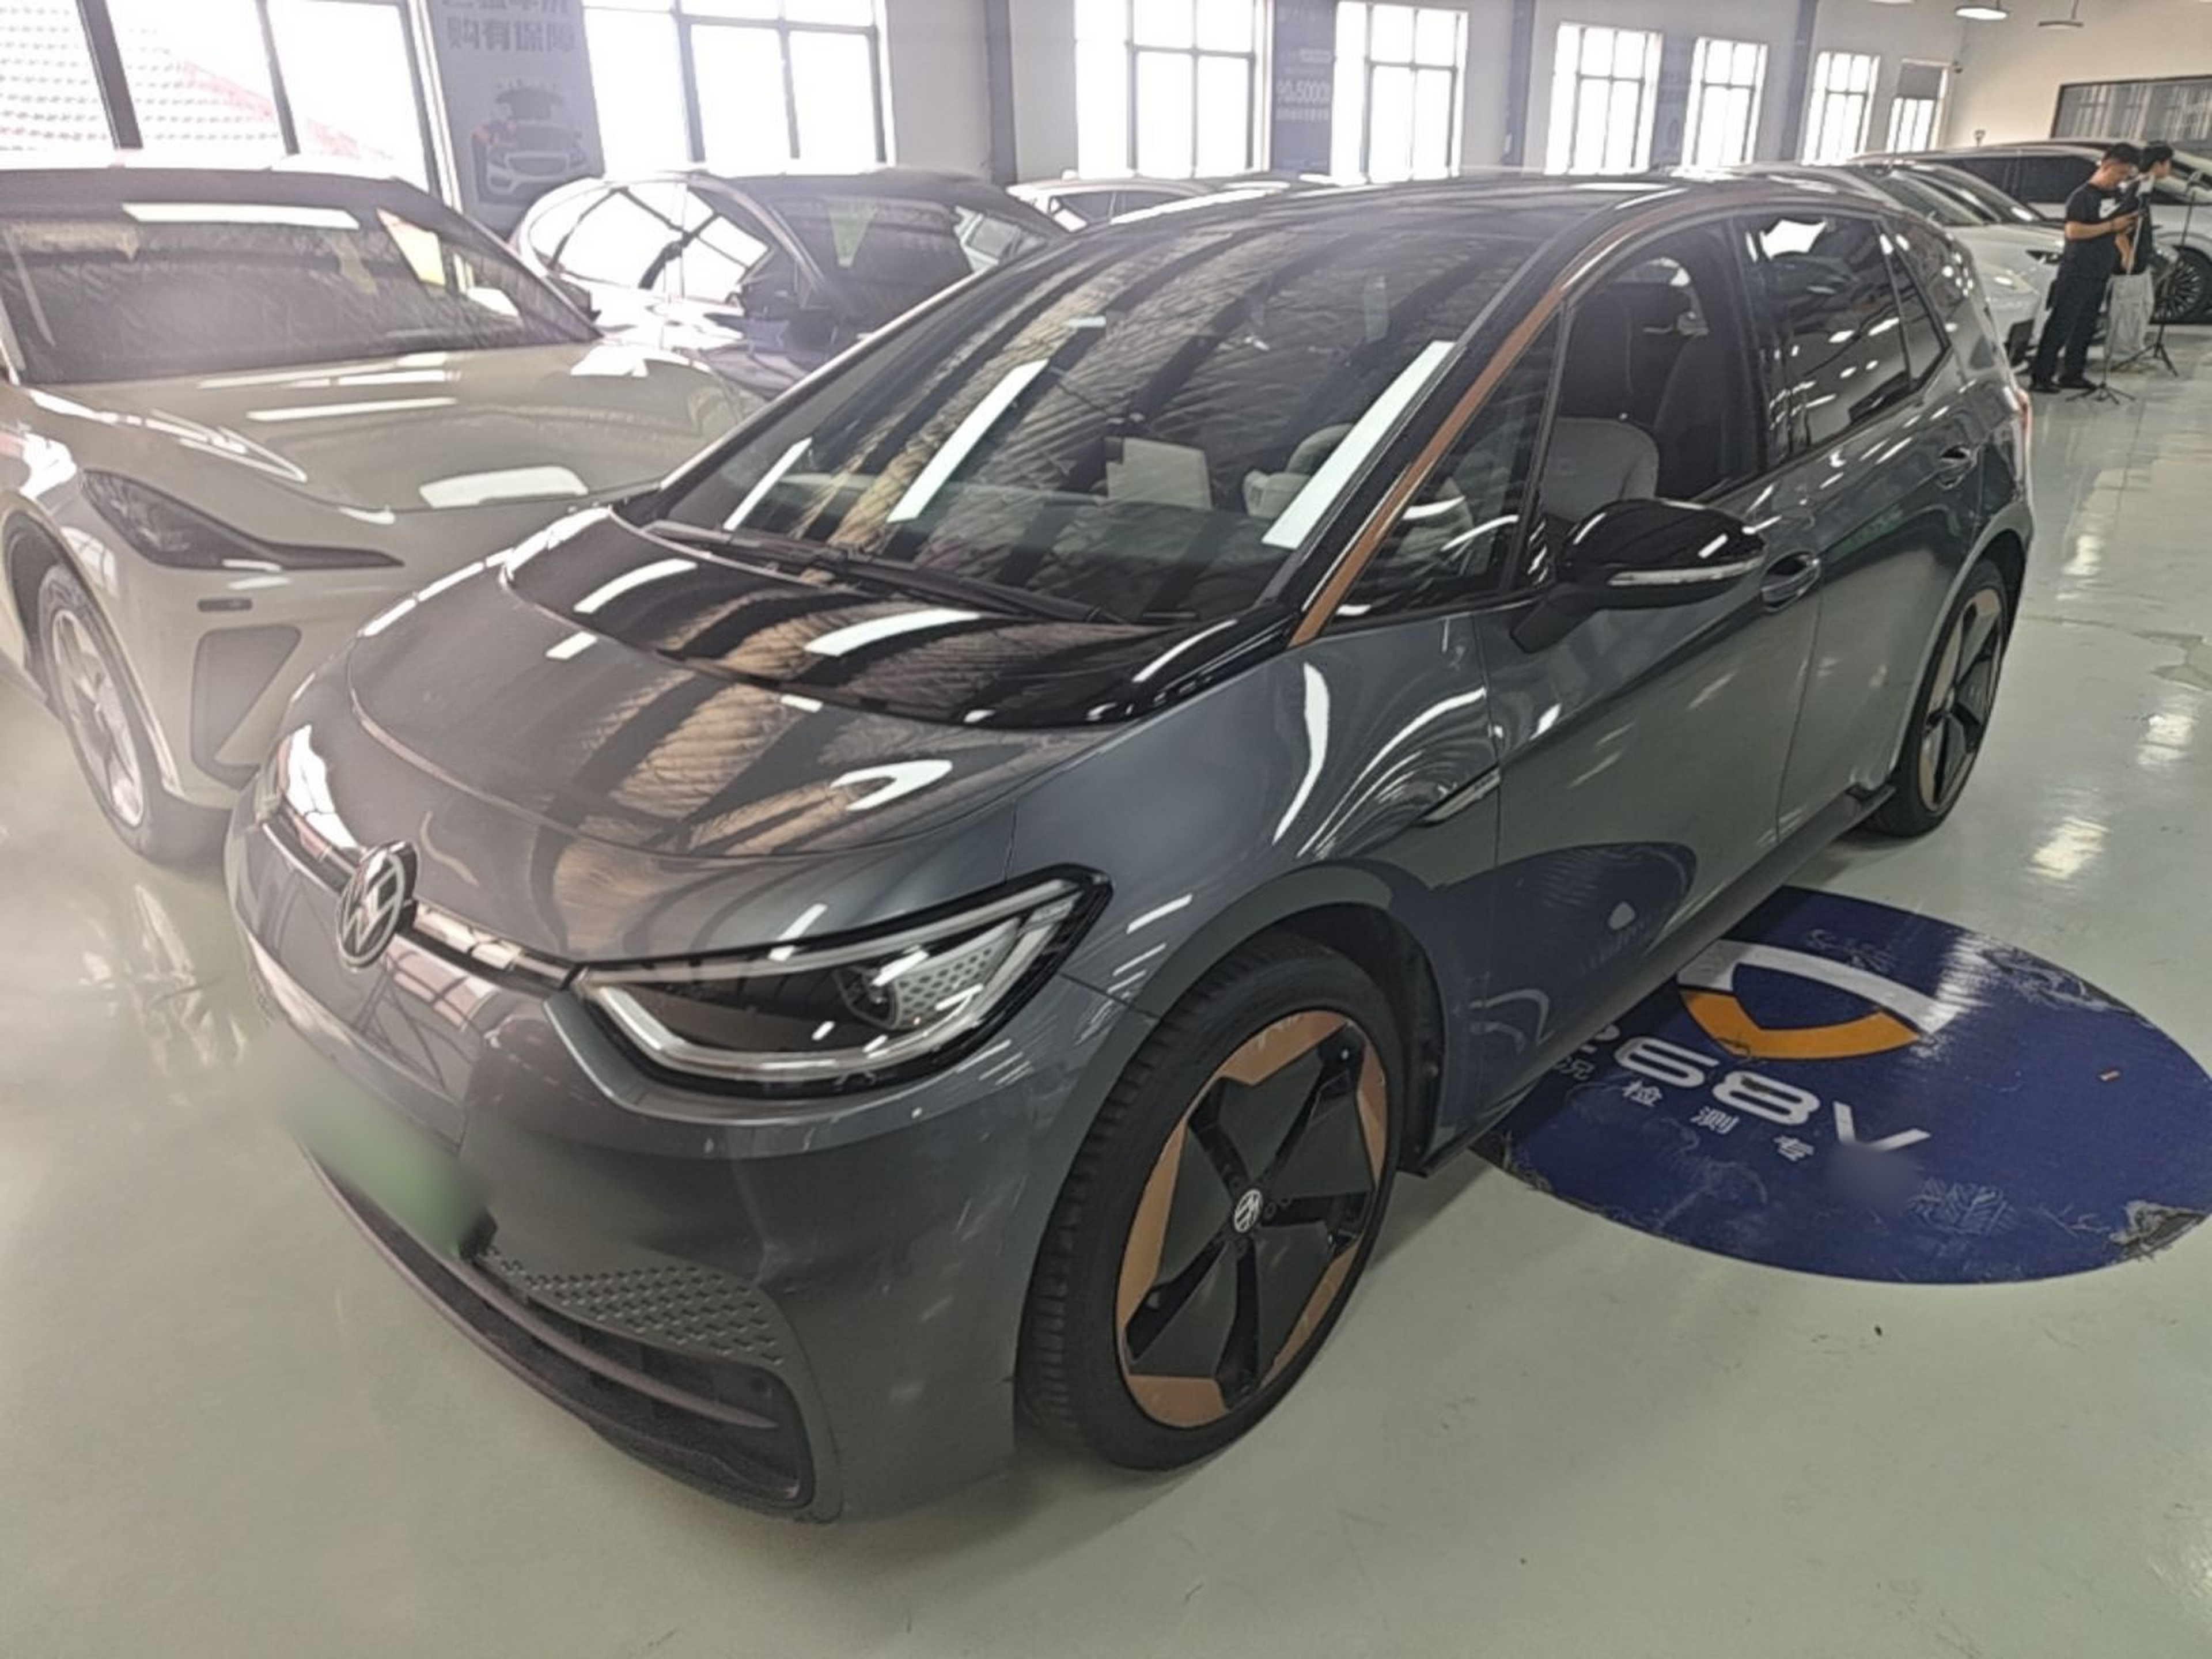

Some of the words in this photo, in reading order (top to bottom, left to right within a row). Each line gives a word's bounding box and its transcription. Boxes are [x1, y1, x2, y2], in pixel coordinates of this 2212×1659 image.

[1556, 1056, 1815, 1162] 况检测专
[1581, 1024, 1931, 1152] 68V
